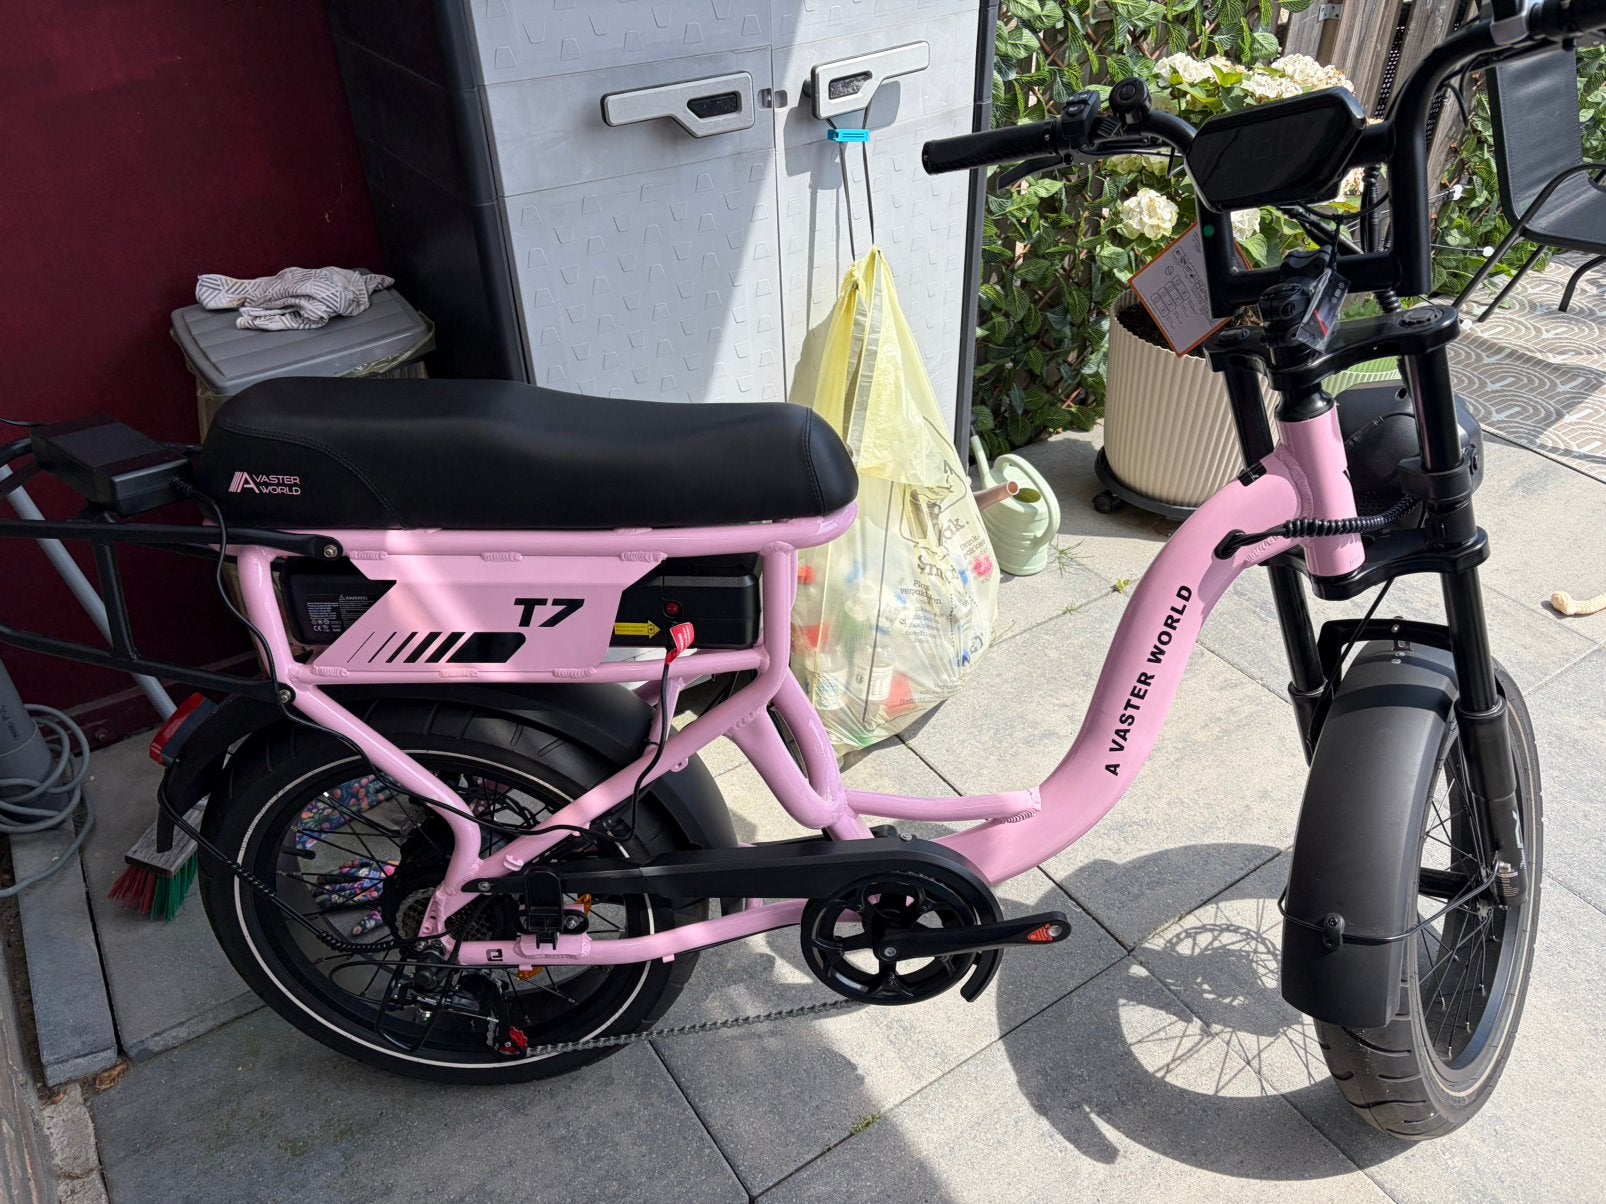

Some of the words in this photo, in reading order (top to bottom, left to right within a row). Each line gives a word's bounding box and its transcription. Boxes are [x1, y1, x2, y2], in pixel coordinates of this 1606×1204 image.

[252, 474, 301, 485] VASTER
[259, 485, 301, 495] WORLD
[513, 597, 585, 628] T7
[1146, 585, 1193, 664] WORLD
[1108, 671, 1156, 752] VASTER
[1104, 763, 1121, 776] A
